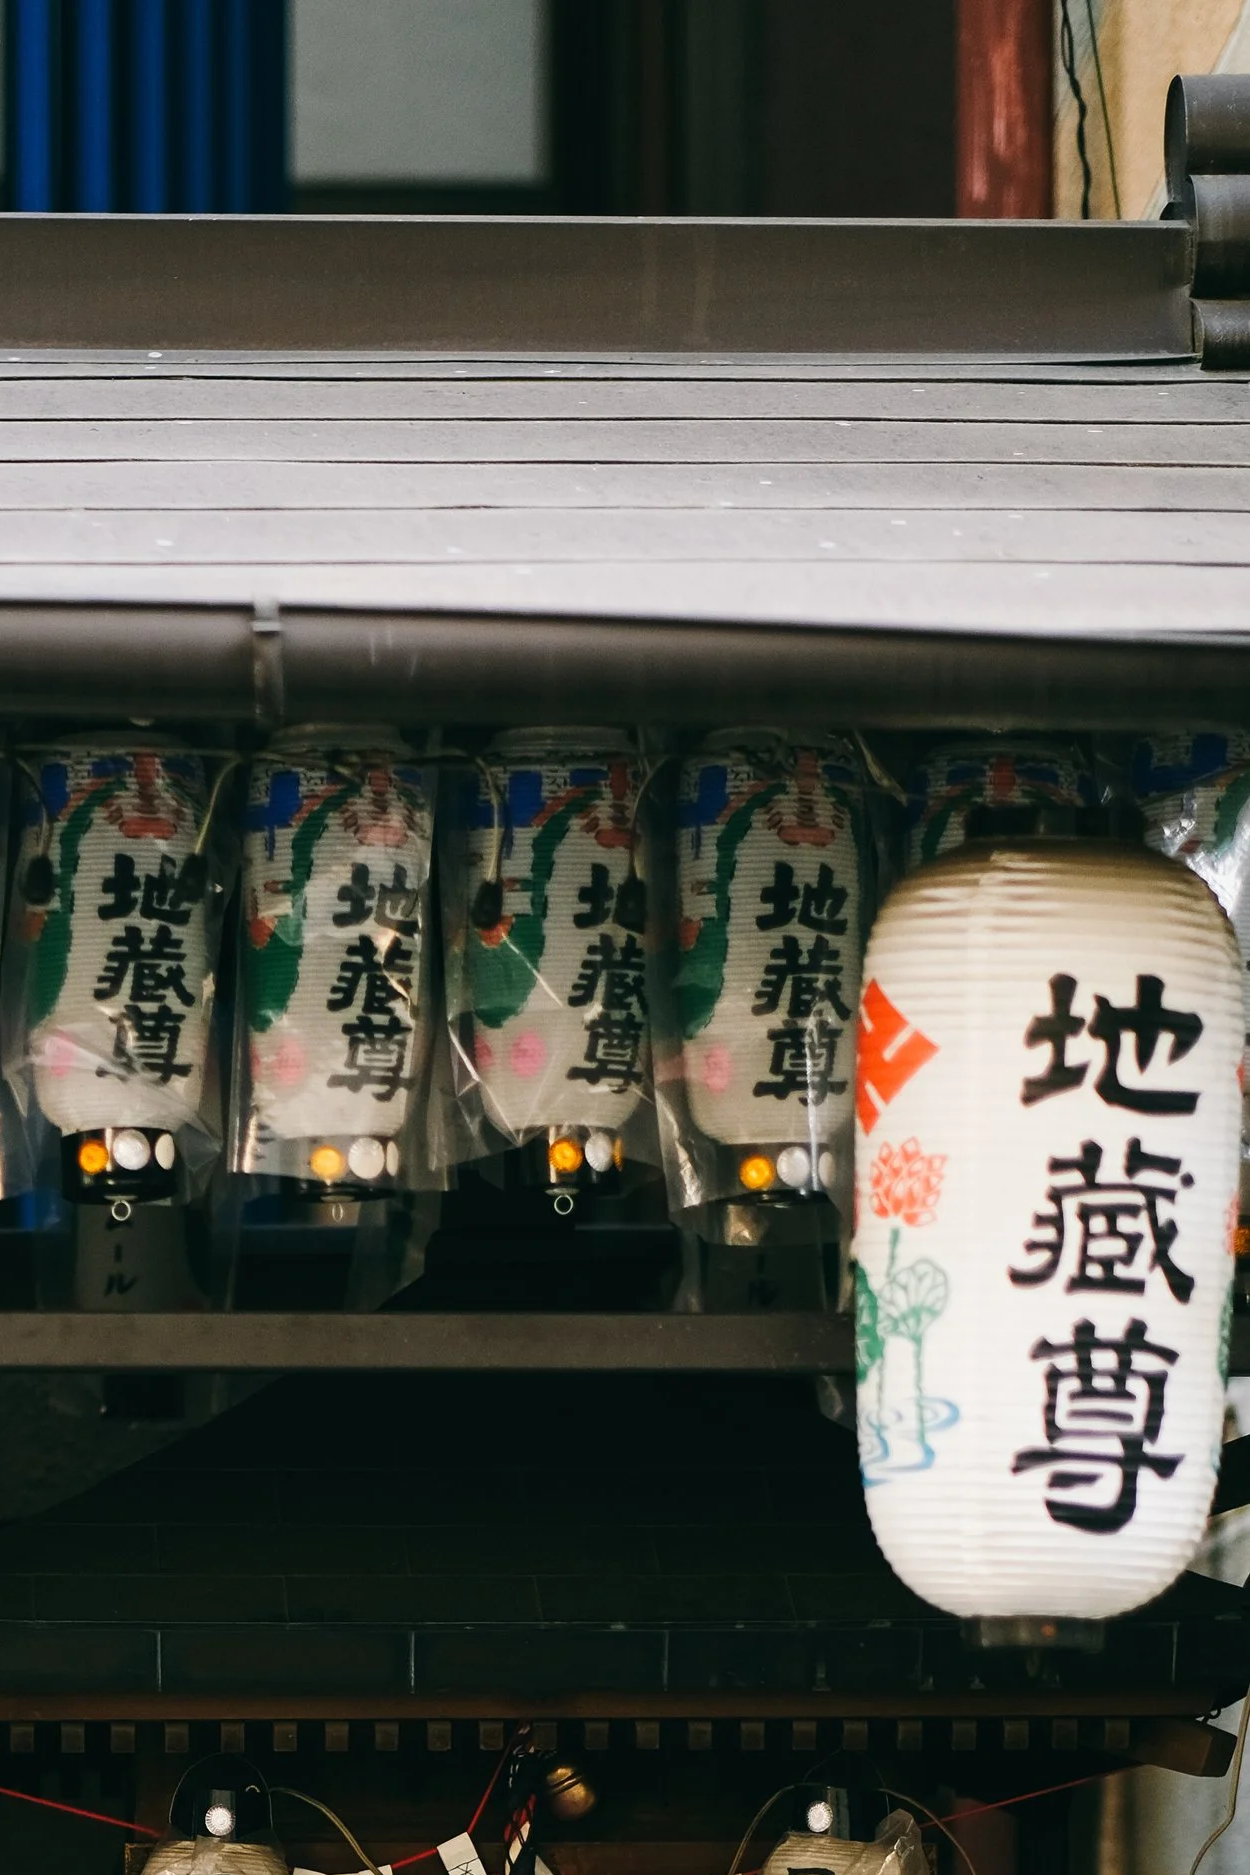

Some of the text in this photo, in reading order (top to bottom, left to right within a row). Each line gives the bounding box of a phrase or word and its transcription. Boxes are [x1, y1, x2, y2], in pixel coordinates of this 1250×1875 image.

[94, 853, 196, 1085] 地蔵尊
[326, 862, 417, 1102] 地蔵尊
[752, 861, 853, 1107] 地蔵尊
[1008, 973, 1205, 1535] 地蔵尊
